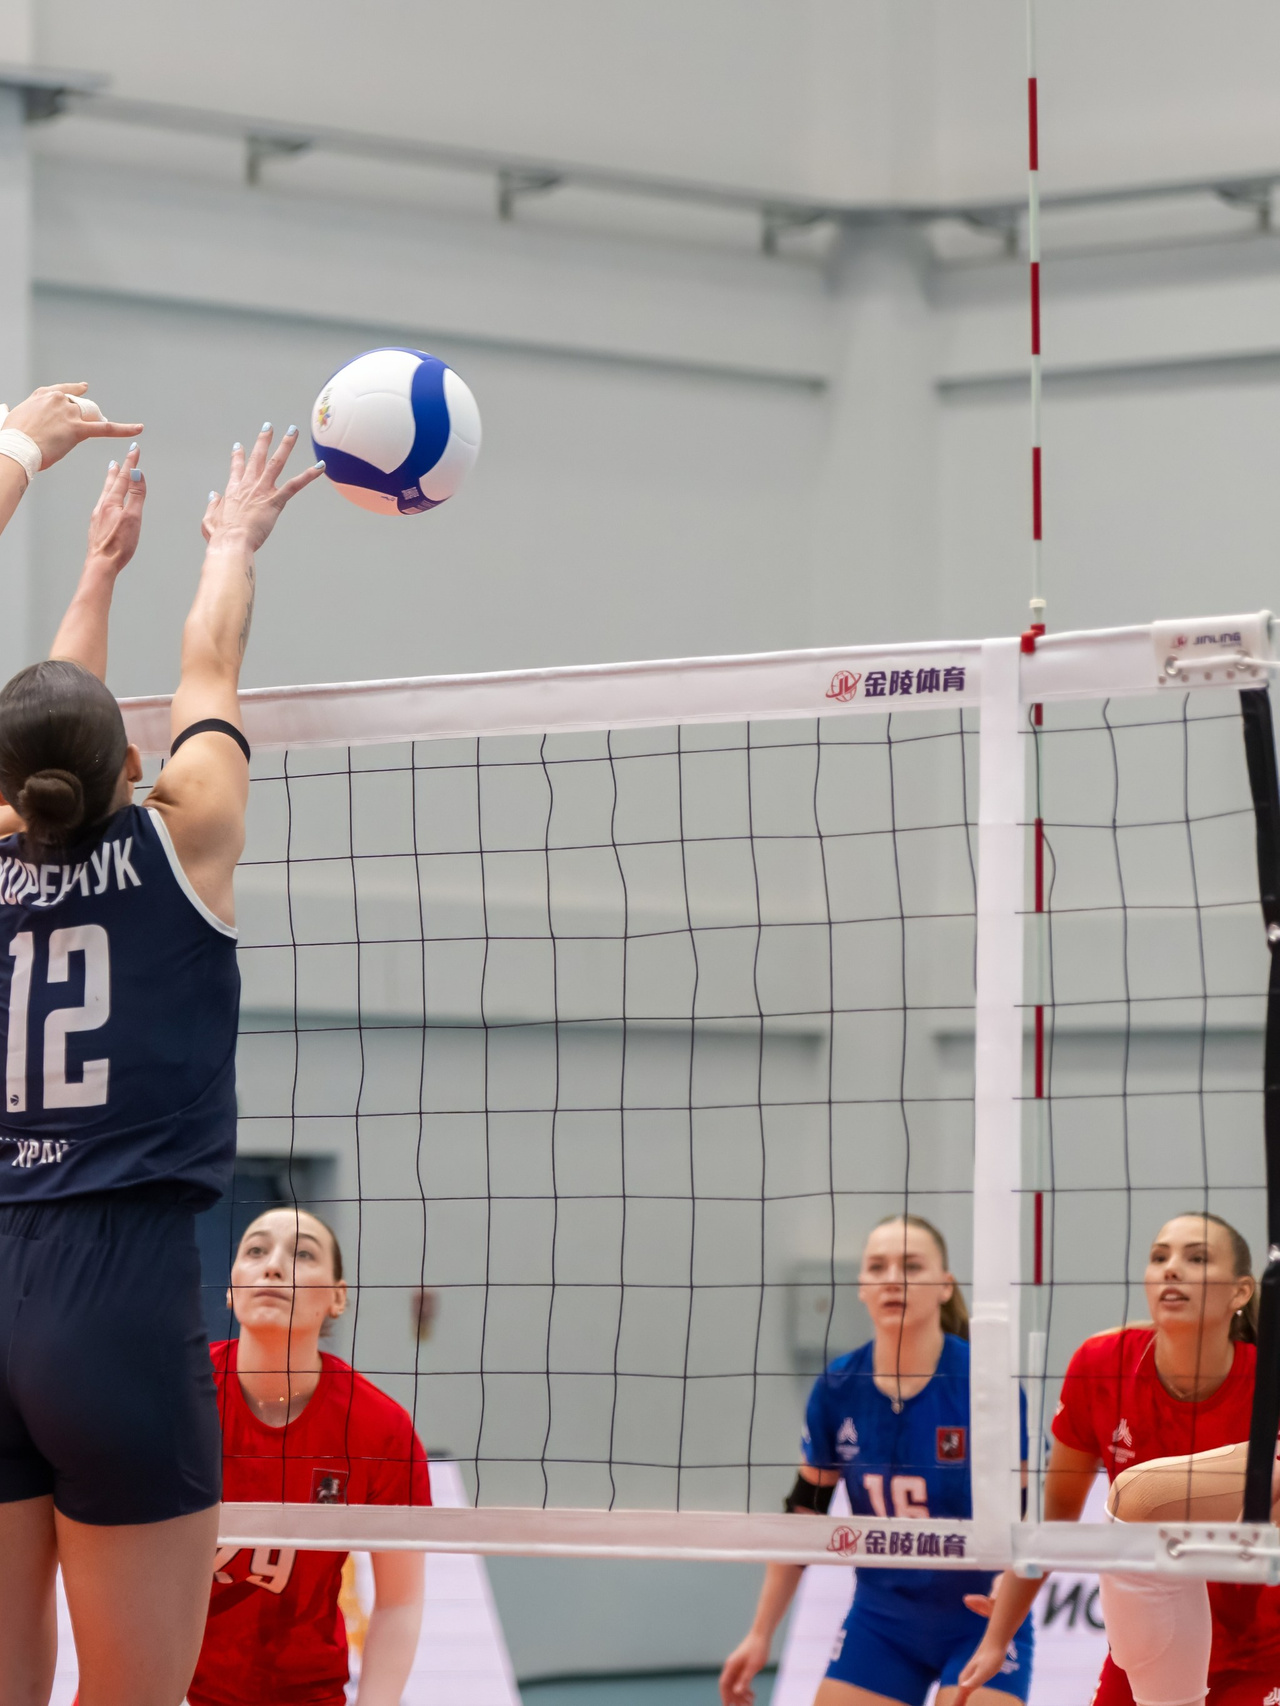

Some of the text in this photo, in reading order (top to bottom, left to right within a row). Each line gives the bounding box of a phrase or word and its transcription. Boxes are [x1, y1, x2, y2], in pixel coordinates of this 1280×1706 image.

[864, 667, 966, 698] 金陵体育
[6, 924, 111, 1113] 12
[863, 1474, 931, 1518] 16
[865, 1530, 966, 1558] 金陵体育
